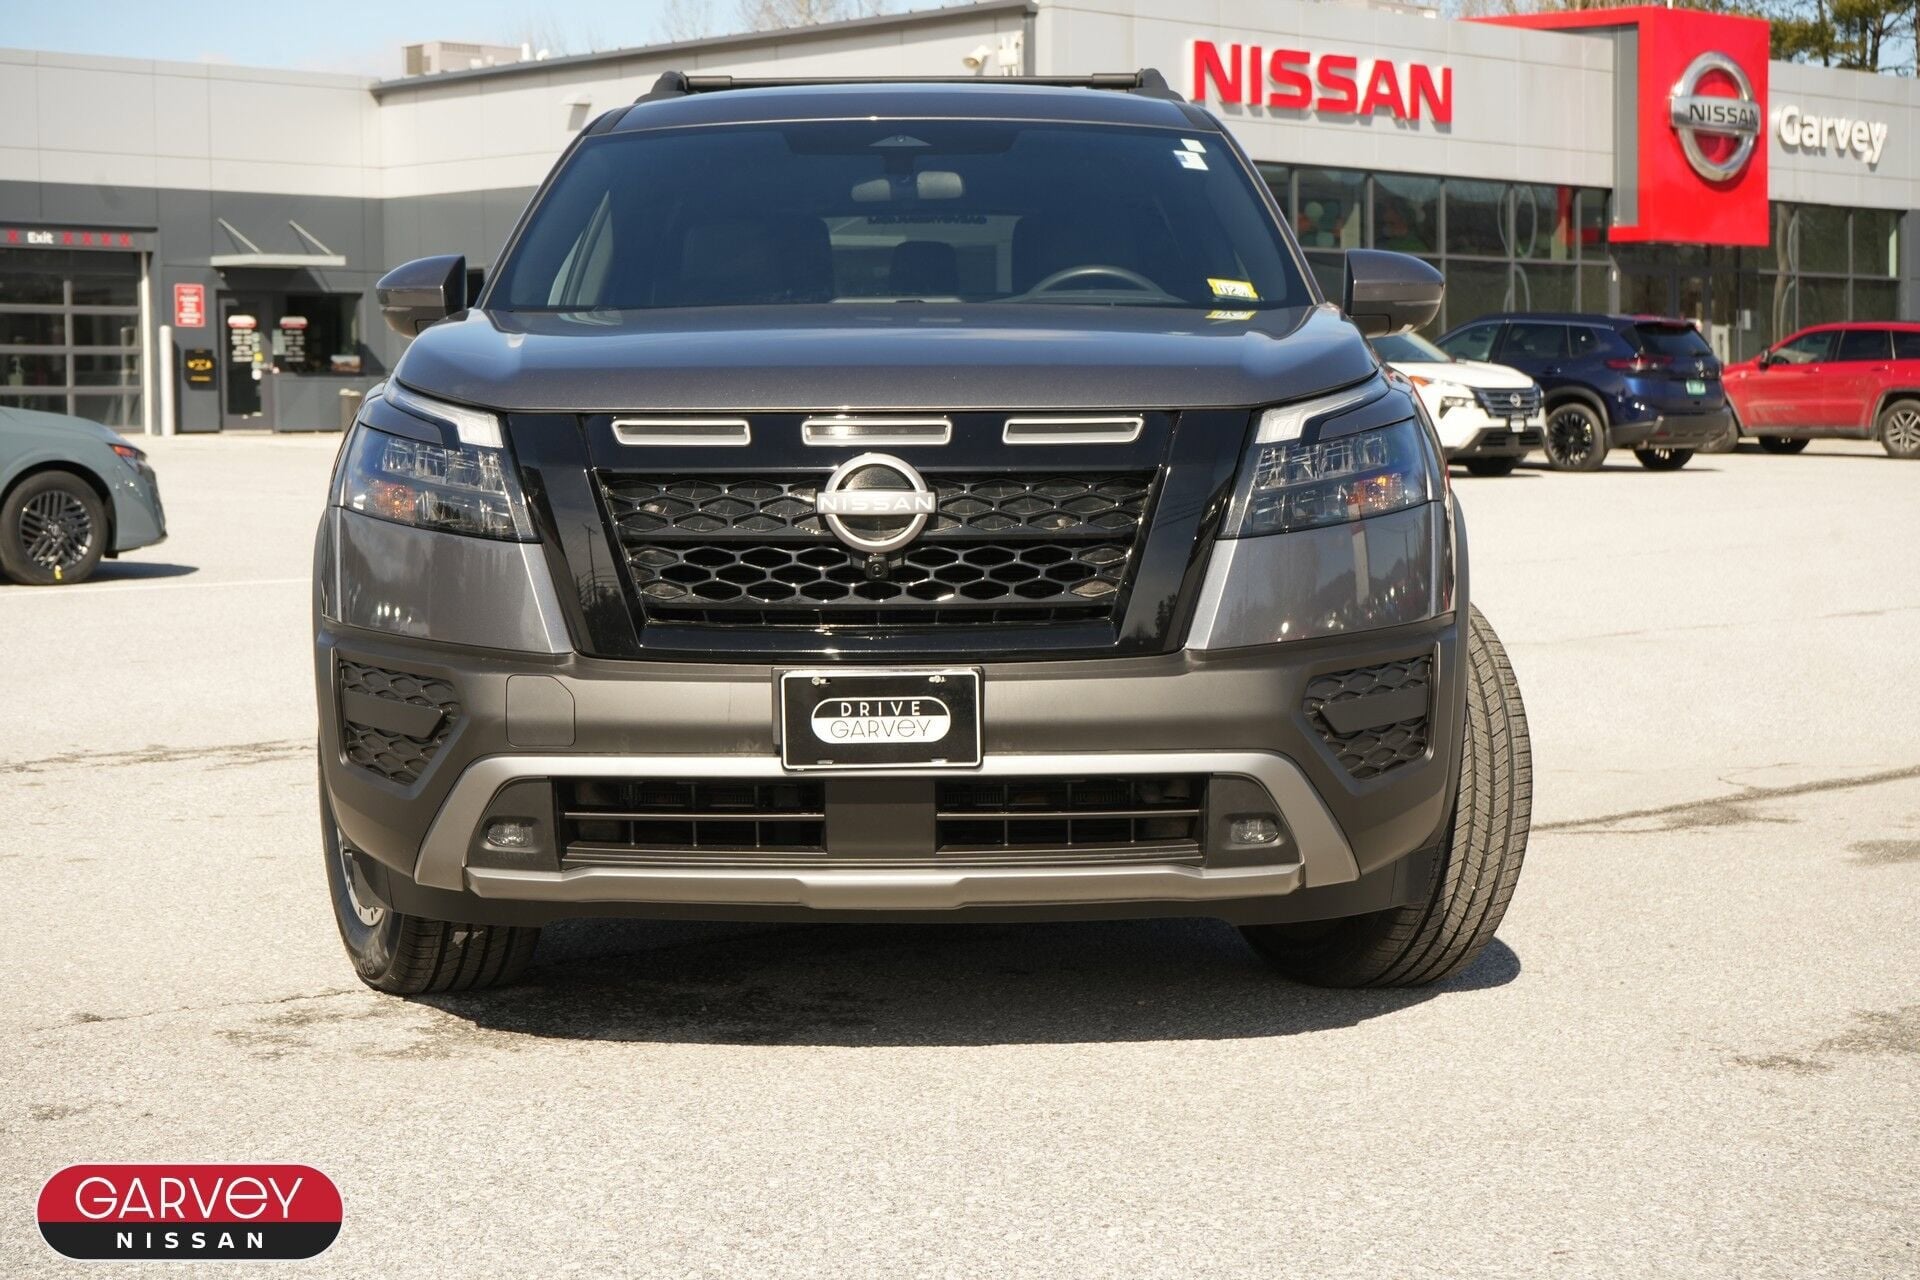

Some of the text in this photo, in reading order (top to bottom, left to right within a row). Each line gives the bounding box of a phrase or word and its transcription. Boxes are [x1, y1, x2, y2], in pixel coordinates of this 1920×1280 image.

[1194, 40, 1452, 123] NISSAN
[1689, 104, 1759, 126] NISSAN
[1779, 105, 1888, 164] Garvey
[27, 231, 54, 244] Exit
[820, 496, 932, 511] NISSAN
[841, 701, 921, 716] DRIVE
